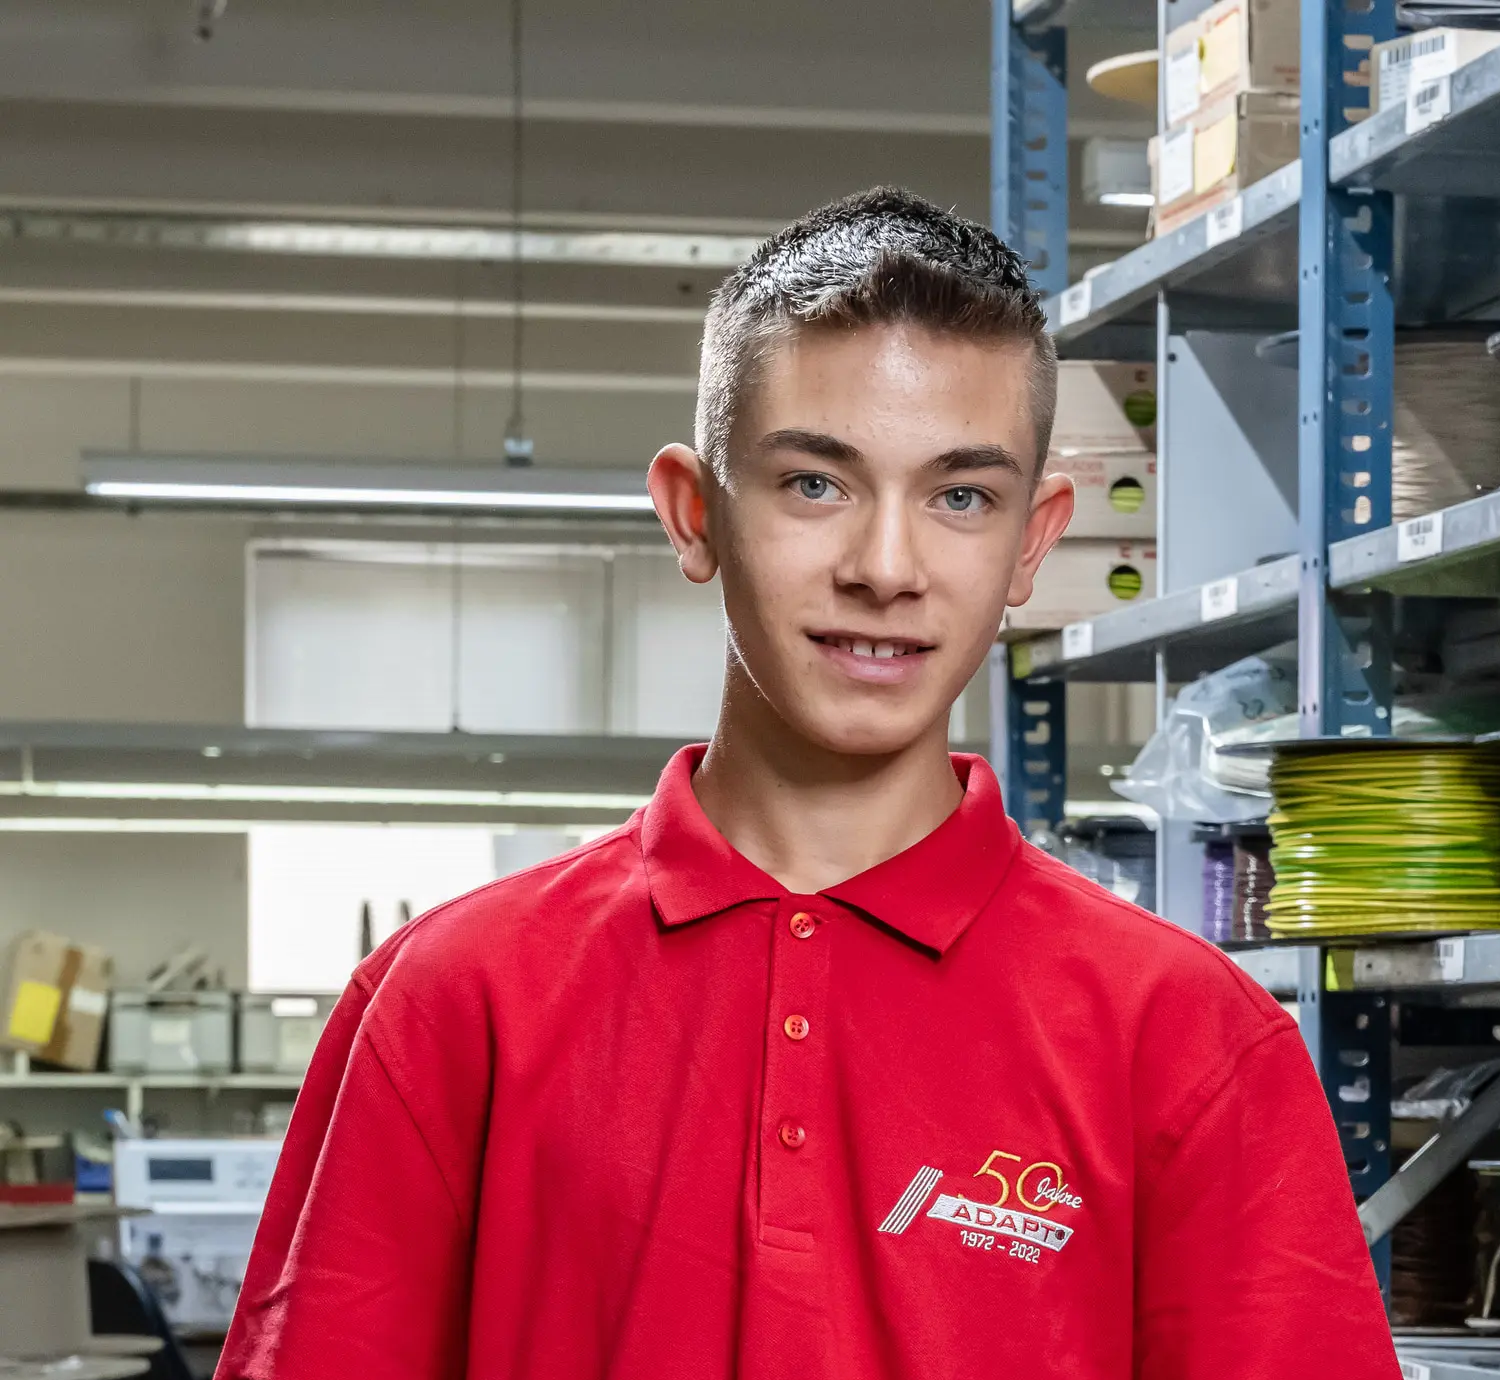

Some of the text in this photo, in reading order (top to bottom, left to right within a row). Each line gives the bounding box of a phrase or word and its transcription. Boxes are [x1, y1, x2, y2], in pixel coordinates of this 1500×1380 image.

[957, 1150, 1083, 1212] 50 Jahre
[960, 1230, 995, 1251] 1972
[1008, 1241, 1041, 1264] 2022
